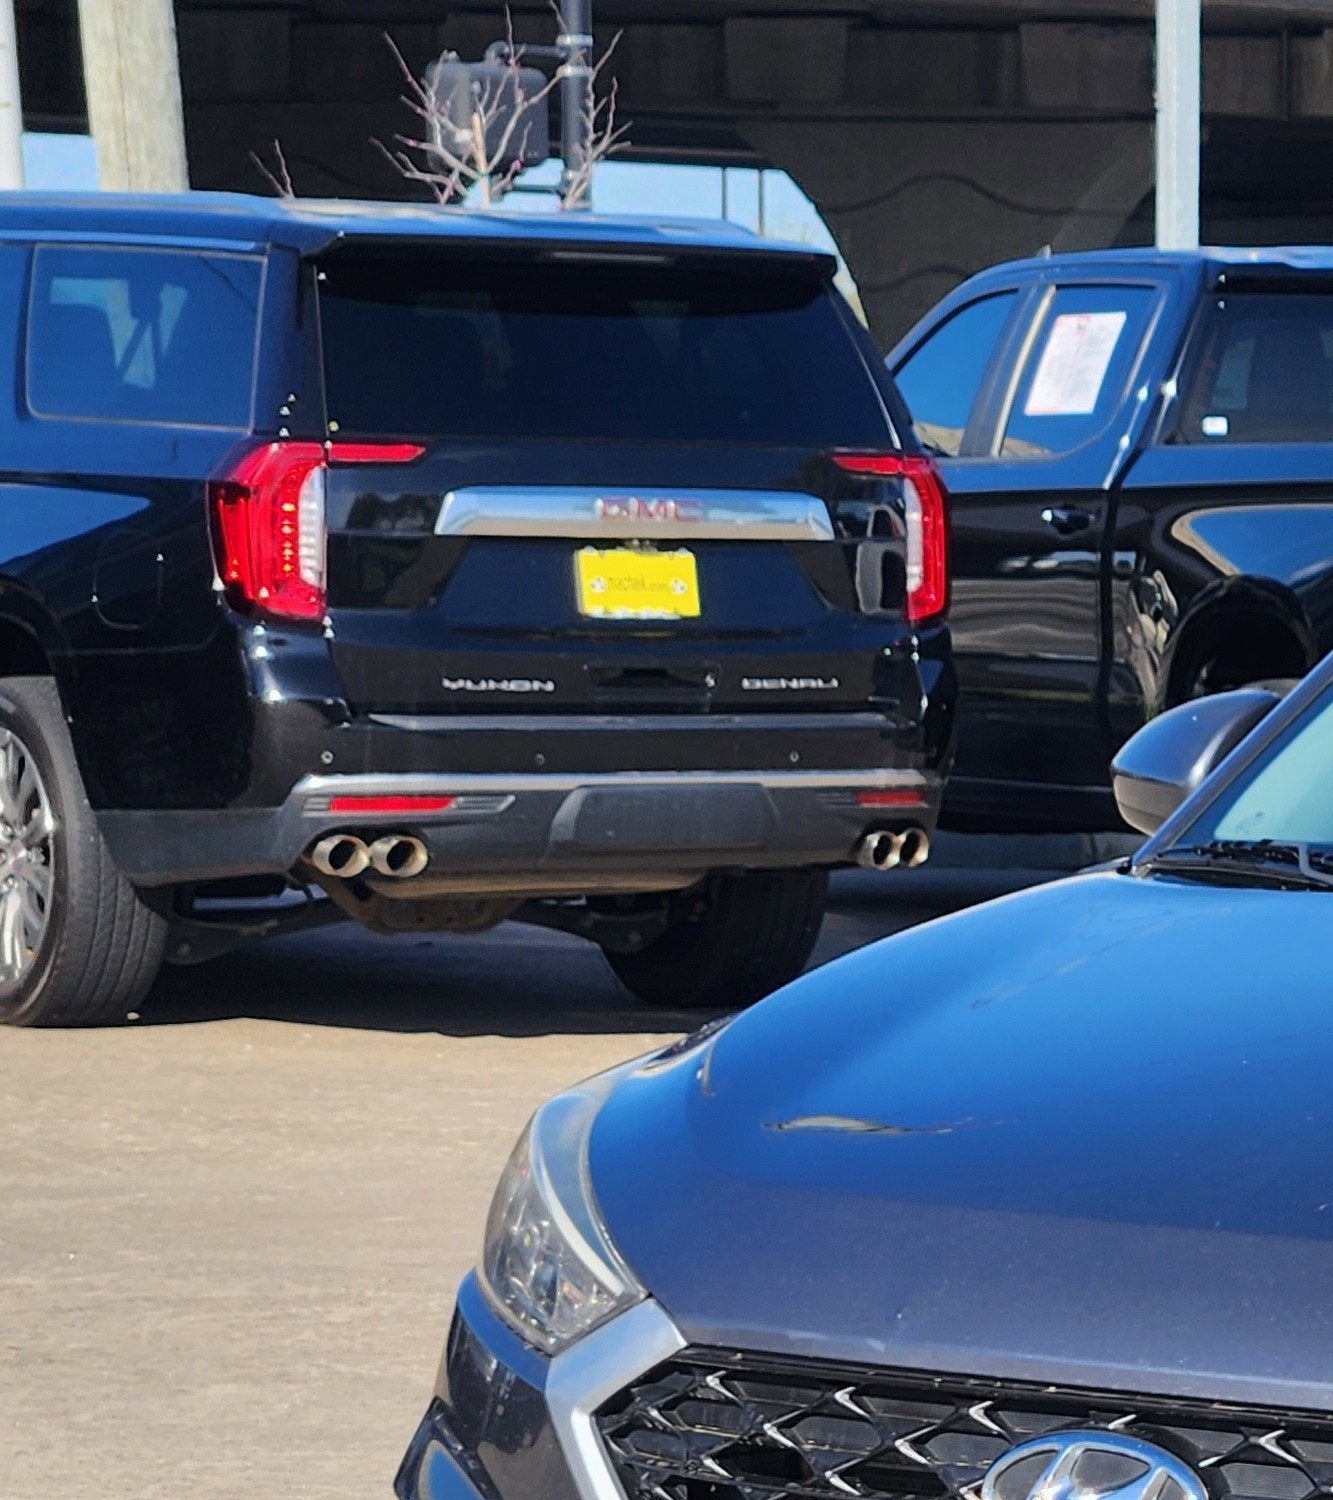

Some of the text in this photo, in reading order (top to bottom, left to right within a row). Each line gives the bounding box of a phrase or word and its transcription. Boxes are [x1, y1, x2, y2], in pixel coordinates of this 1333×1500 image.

[594, 496, 701, 523] GMC
[442, 677, 839, 692] YUKON DENALI
